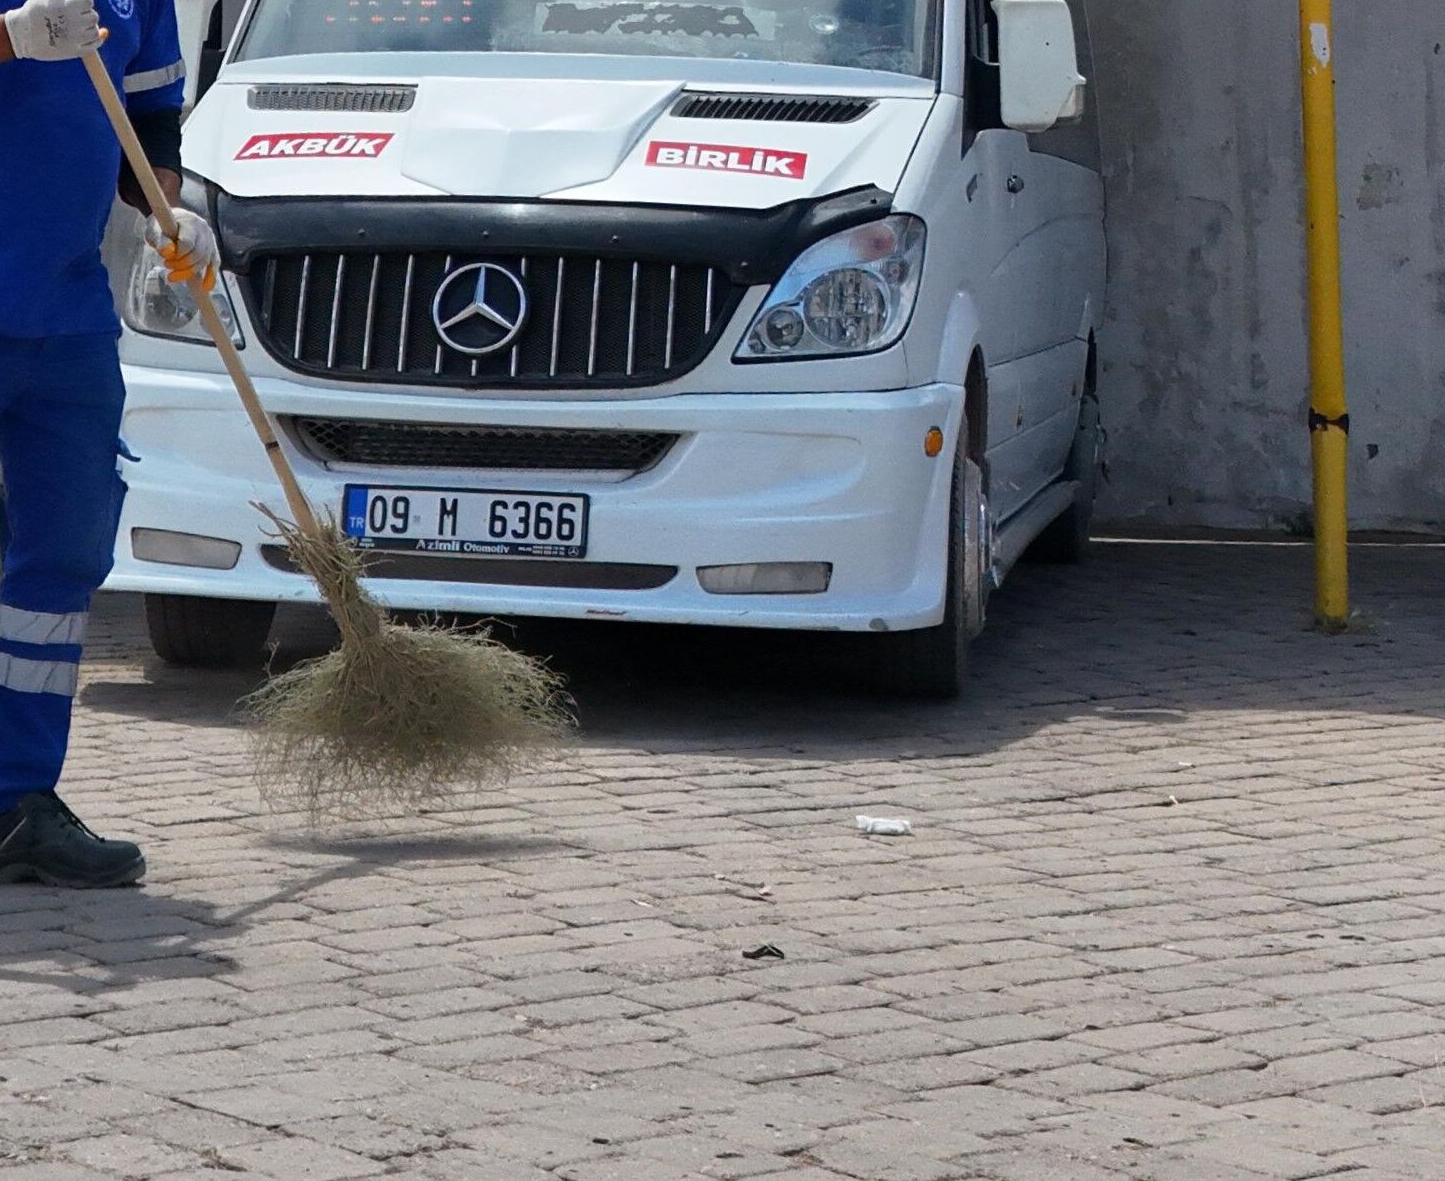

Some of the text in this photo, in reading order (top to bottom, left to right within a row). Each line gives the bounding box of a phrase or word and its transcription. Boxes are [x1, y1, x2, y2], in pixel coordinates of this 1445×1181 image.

[238, 134, 385, 158] AKBÜK
[655, 145, 795, 176] BİRLİK
[348, 516, 365, 529] TR
[368, 494, 577, 542] 09 M 6366
[416, 539, 460, 552] Azimli
[463, 542, 510, 554] Otomotiv
